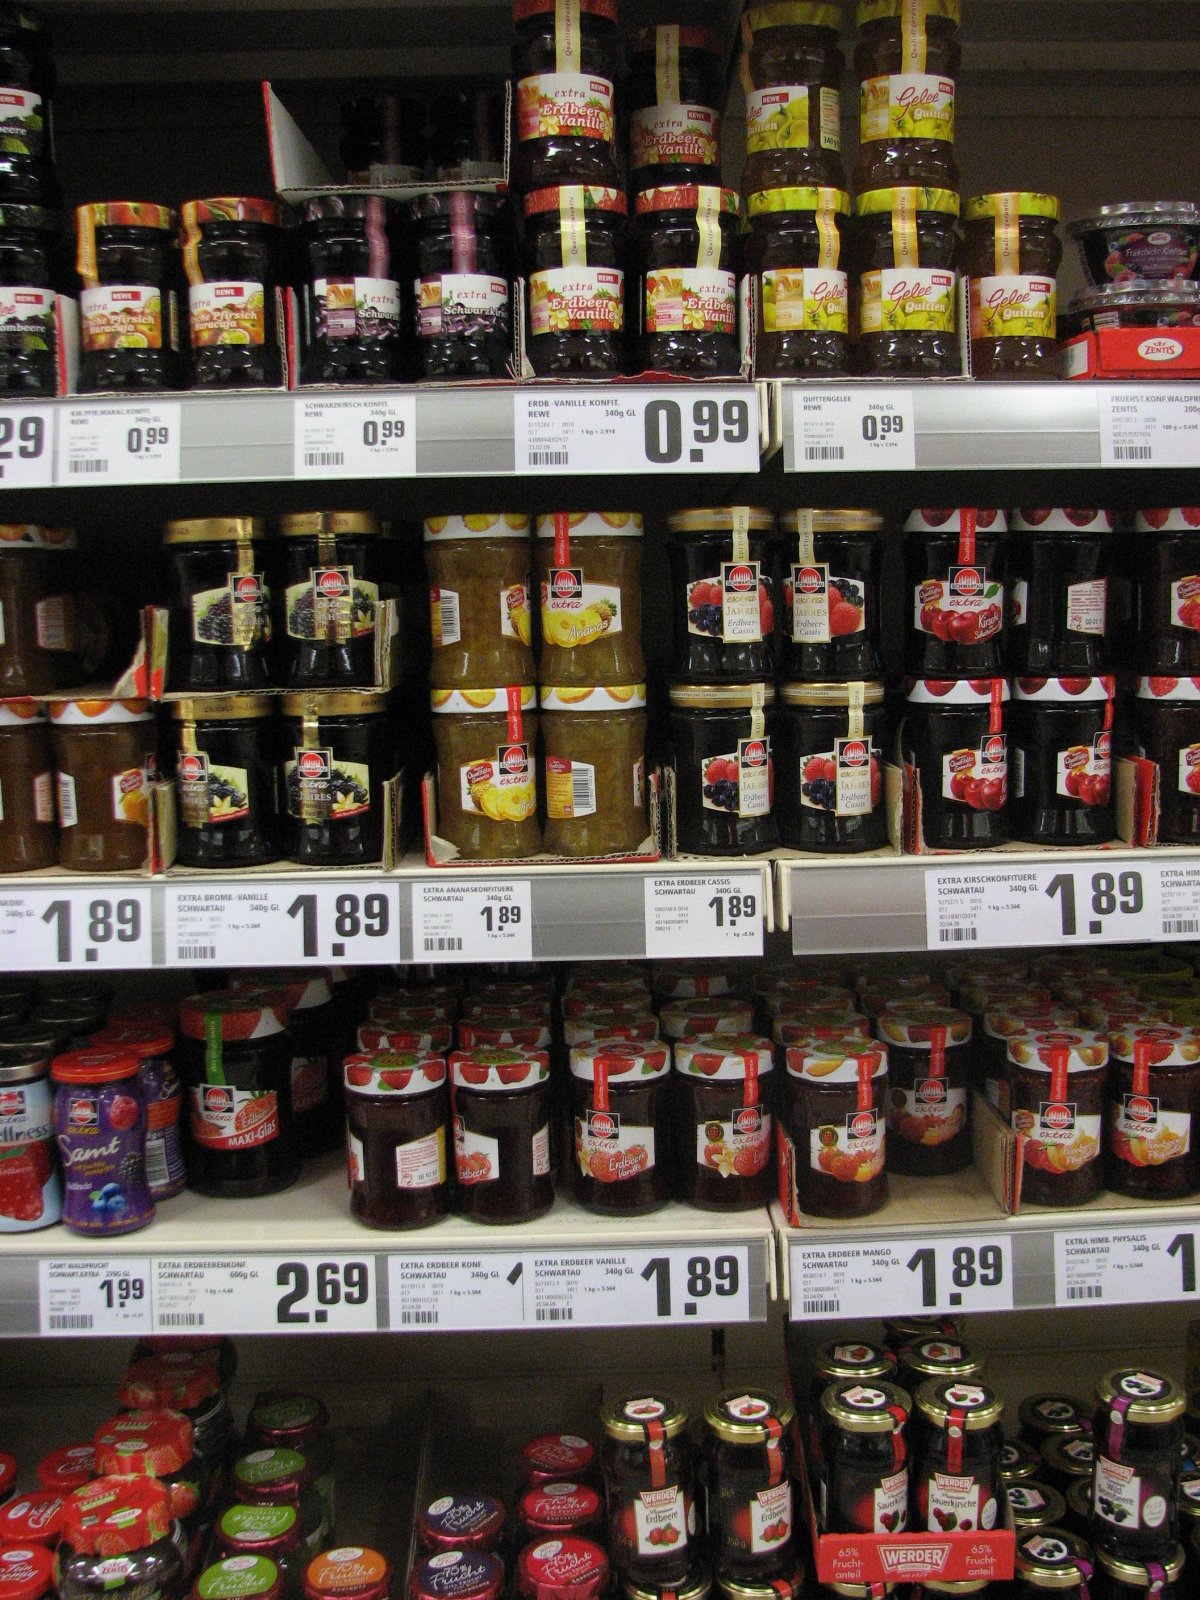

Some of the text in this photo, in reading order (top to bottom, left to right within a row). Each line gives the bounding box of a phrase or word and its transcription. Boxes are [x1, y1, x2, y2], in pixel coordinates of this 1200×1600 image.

[554, 88, 587, 99] extra
[896, 86, 940, 121] Gelee
[542, 103, 601, 117] Erdbeer
[559, 115, 607, 130] Vanille
[653, 119, 684, 129] extra
[645, 131, 698, 146] Erdbeer
[658, 145, 706, 156] Vanille
[561, 283, 593, 292] extra
[699, 284, 726, 294] extra
[1030, 284, 1047, 292] REWE
[456, 291, 488, 300] extra
[886, 280, 933, 316] Gelee
[551, 295, 609, 310] Erdbeer
[904, 302, 946, 313] Quitten
[985, 288, 1031, 323] Gelee
[567, 310, 615, 320] Vanille
[1003, 307, 1046, 320] Quitten
[1144, 346, 1175, 356] ZENTIS
[527, 399, 620, 408] ERDB.-VANILLE KONFIT.
[803, 396, 852, 404] QUITTENGELEE
[305, 402, 362, 410] SCHWARZKIRSCH
[868, 404, 885, 412] 340g
[1111, 405, 1138, 414] ZENTIS
[528, 410, 551, 419] REWE
[604, 409, 637, 420] 340g GL
[363, 420, 406, 447] 0.99
[644, 399, 749, 464] 0.99
[862, 415, 904, 441] 0.99
[127, 427, 169, 453] 0.99
[551, 599, 584, 610] extra
[949, 599, 984, 608] extra
[568, 620, 609, 642] Ananas
[500, 775, 528, 786] extra
[937, 873, 1037, 885] EXTRA KIRSCHKONFITUERE
[1160, 870, 1184, 878] EXTRA
[707, 878, 731, 886] CASSIS
[446, 885, 514, 893] ANANASKONFITUERE
[654, 888, 696, 896] SCHWARTAU
[715, 887, 732, 895] 340G
[938, 886, 985, 896] SCHWARTAU
[1009, 884, 1039, 894] 340g GL
[178, 894, 202, 902] EXTRA
[423, 895, 464, 903] SCHWARTAU
[486, 895, 502, 903] 340g
[1045, 871, 1144, 936] 1.89
[178, 904, 226, 913] SCHWARTAU
[250, 903, 281, 913] 340g GL
[708, 895, 756, 927] 1.89
[480, 905, 521, 932] 1.89
[41, 898, 142, 963] 1.89
[286, 893, 390, 958] 1.89
[228, 1119, 277, 1147] MAXI-Glas
[1123, 1121, 1157, 1134] extra
[1040, 1131, 1074, 1140] extra
[58, 1135, 120, 1166] Samt
[587, 1140, 619, 1150] extra
[1065, 1237, 1089, 1246] EXTRA
[1112, 1234, 1147, 1243] PHYSALIS
[1065, 1246, 1110, 1256] SCHWARTAU
[1132, 1243, 1161, 1253] 340g GL
[802, 1248, 892, 1260] EXTRA ERDBEER MANGO
[159, 1261, 182, 1269] EXTRA
[400, 1261, 483, 1270] EXTRA ERDBEER KONF.
[534, 1258, 627, 1268] EXTRA ERDBEER VANILLE
[802, 1260, 848, 1270] SCHWARTAU
[871, 1258, 901, 1268] 340g GL
[158, 1270, 205, 1280] SCHWARTAU
[249, 1270, 260, 1279] GL
[400, 1271, 447, 1280] SCHWARTAU
[470, 1270, 501, 1281] 340g GL
[534, 1268, 581, 1278] SCHWARTAU
[605, 1267, 635, 1277] 340g GL
[906, 1244, 1003, 1307] 1.89
[640, 1254, 740, 1317] 1.89
[99, 1278, 145, 1308] 1.99
[276, 1261, 369, 1323] 2.69
[938, 1477, 973, 1489] WERDER
[644, 1490, 676, 1505] WERDER
[930, 1495, 977, 1509] Sauerkirsche
[535, 1498, 591, 1513] Frucht
[645, 1511, 678, 1524] Erdbeere
[838, 1548, 860, 1558] 65%
[971, 1544, 993, 1554] 65%
[885, 1549, 942, 1566] WERDER
[965, 1555, 996, 1566] Frucht-
[541, 1551, 592, 1581] Frucht
[832, 1558, 864, 1569] Frucht-
[835, 1569, 862, 1579] anteil
[968, 1566, 994, 1576] anteil
[429, 1564, 486, 1591] Frucht
